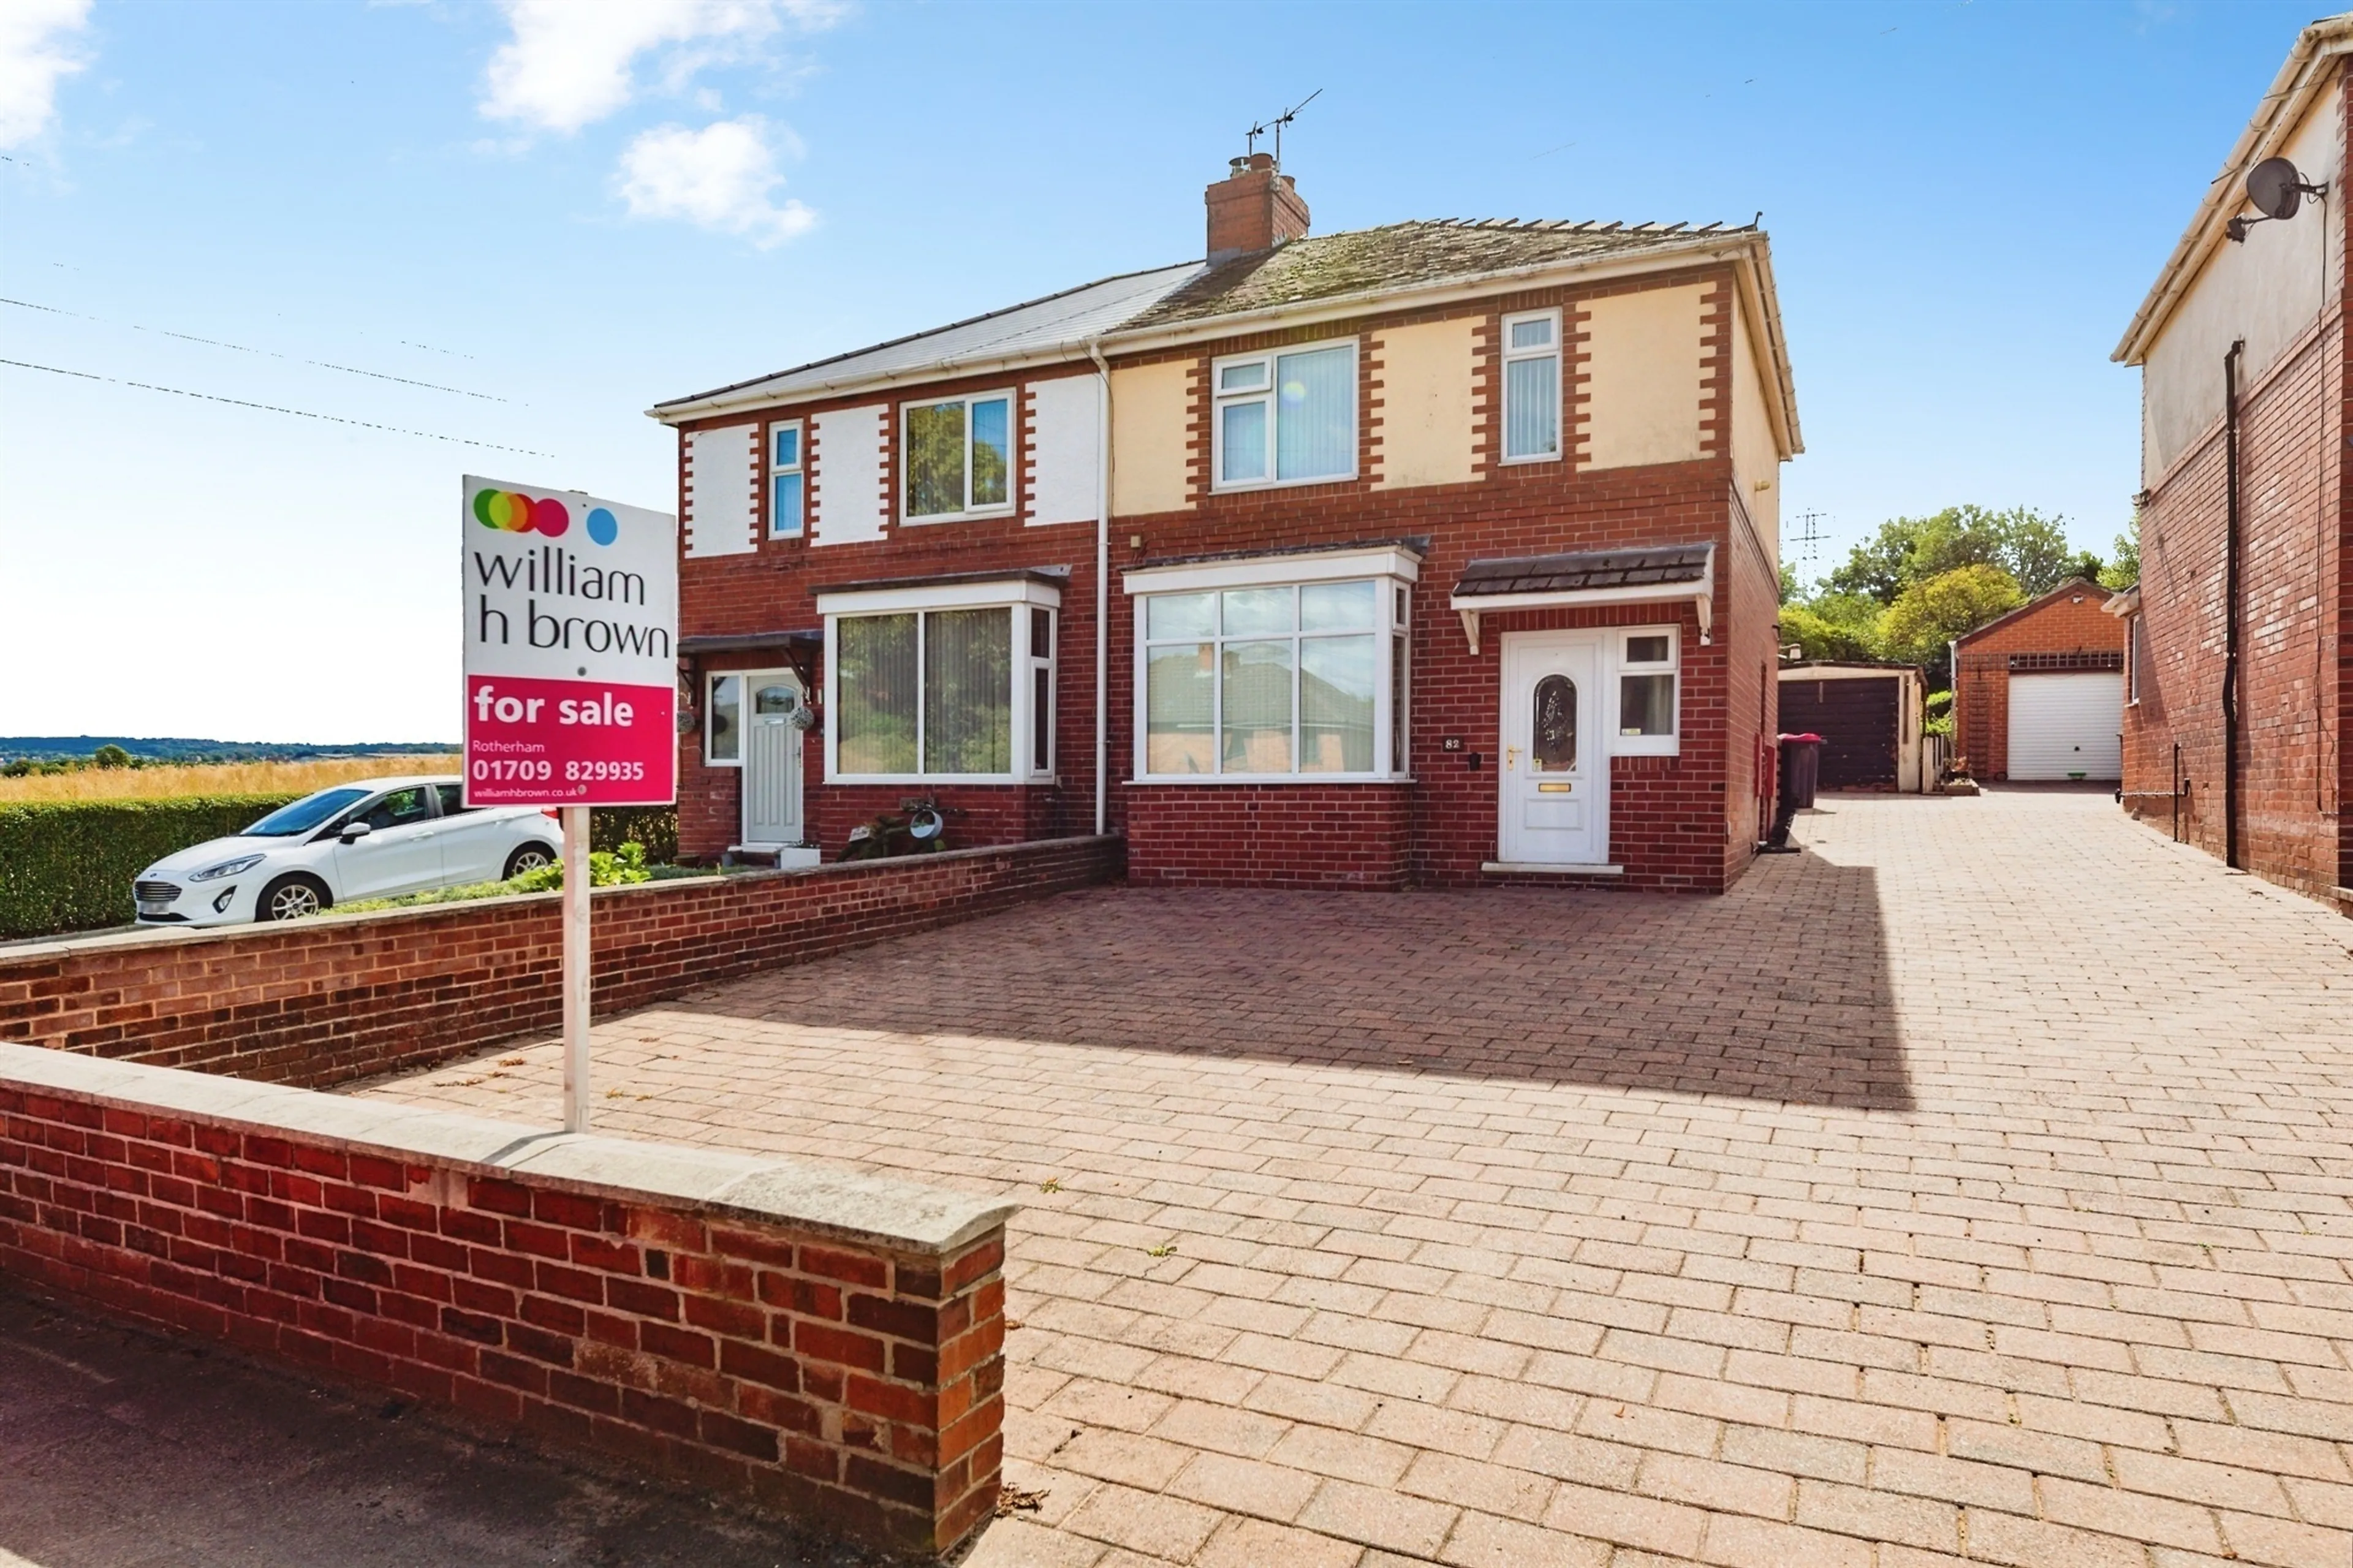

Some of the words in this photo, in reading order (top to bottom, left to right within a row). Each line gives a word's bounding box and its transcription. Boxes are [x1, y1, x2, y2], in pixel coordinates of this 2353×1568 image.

[474, 545, 644, 605] william
[480, 594, 509, 645] h
[529, 599, 669, 658] brown
[474, 685, 545, 724] for
[559, 692, 634, 727] sale
[472, 740, 545, 752] Rotherham
[1446, 739, 1459, 749] 82
[473, 759, 551, 781] 01709
[565, 760, 643, 781] 829935
[474, 787, 578, 798] williamhbrown.co.uk
